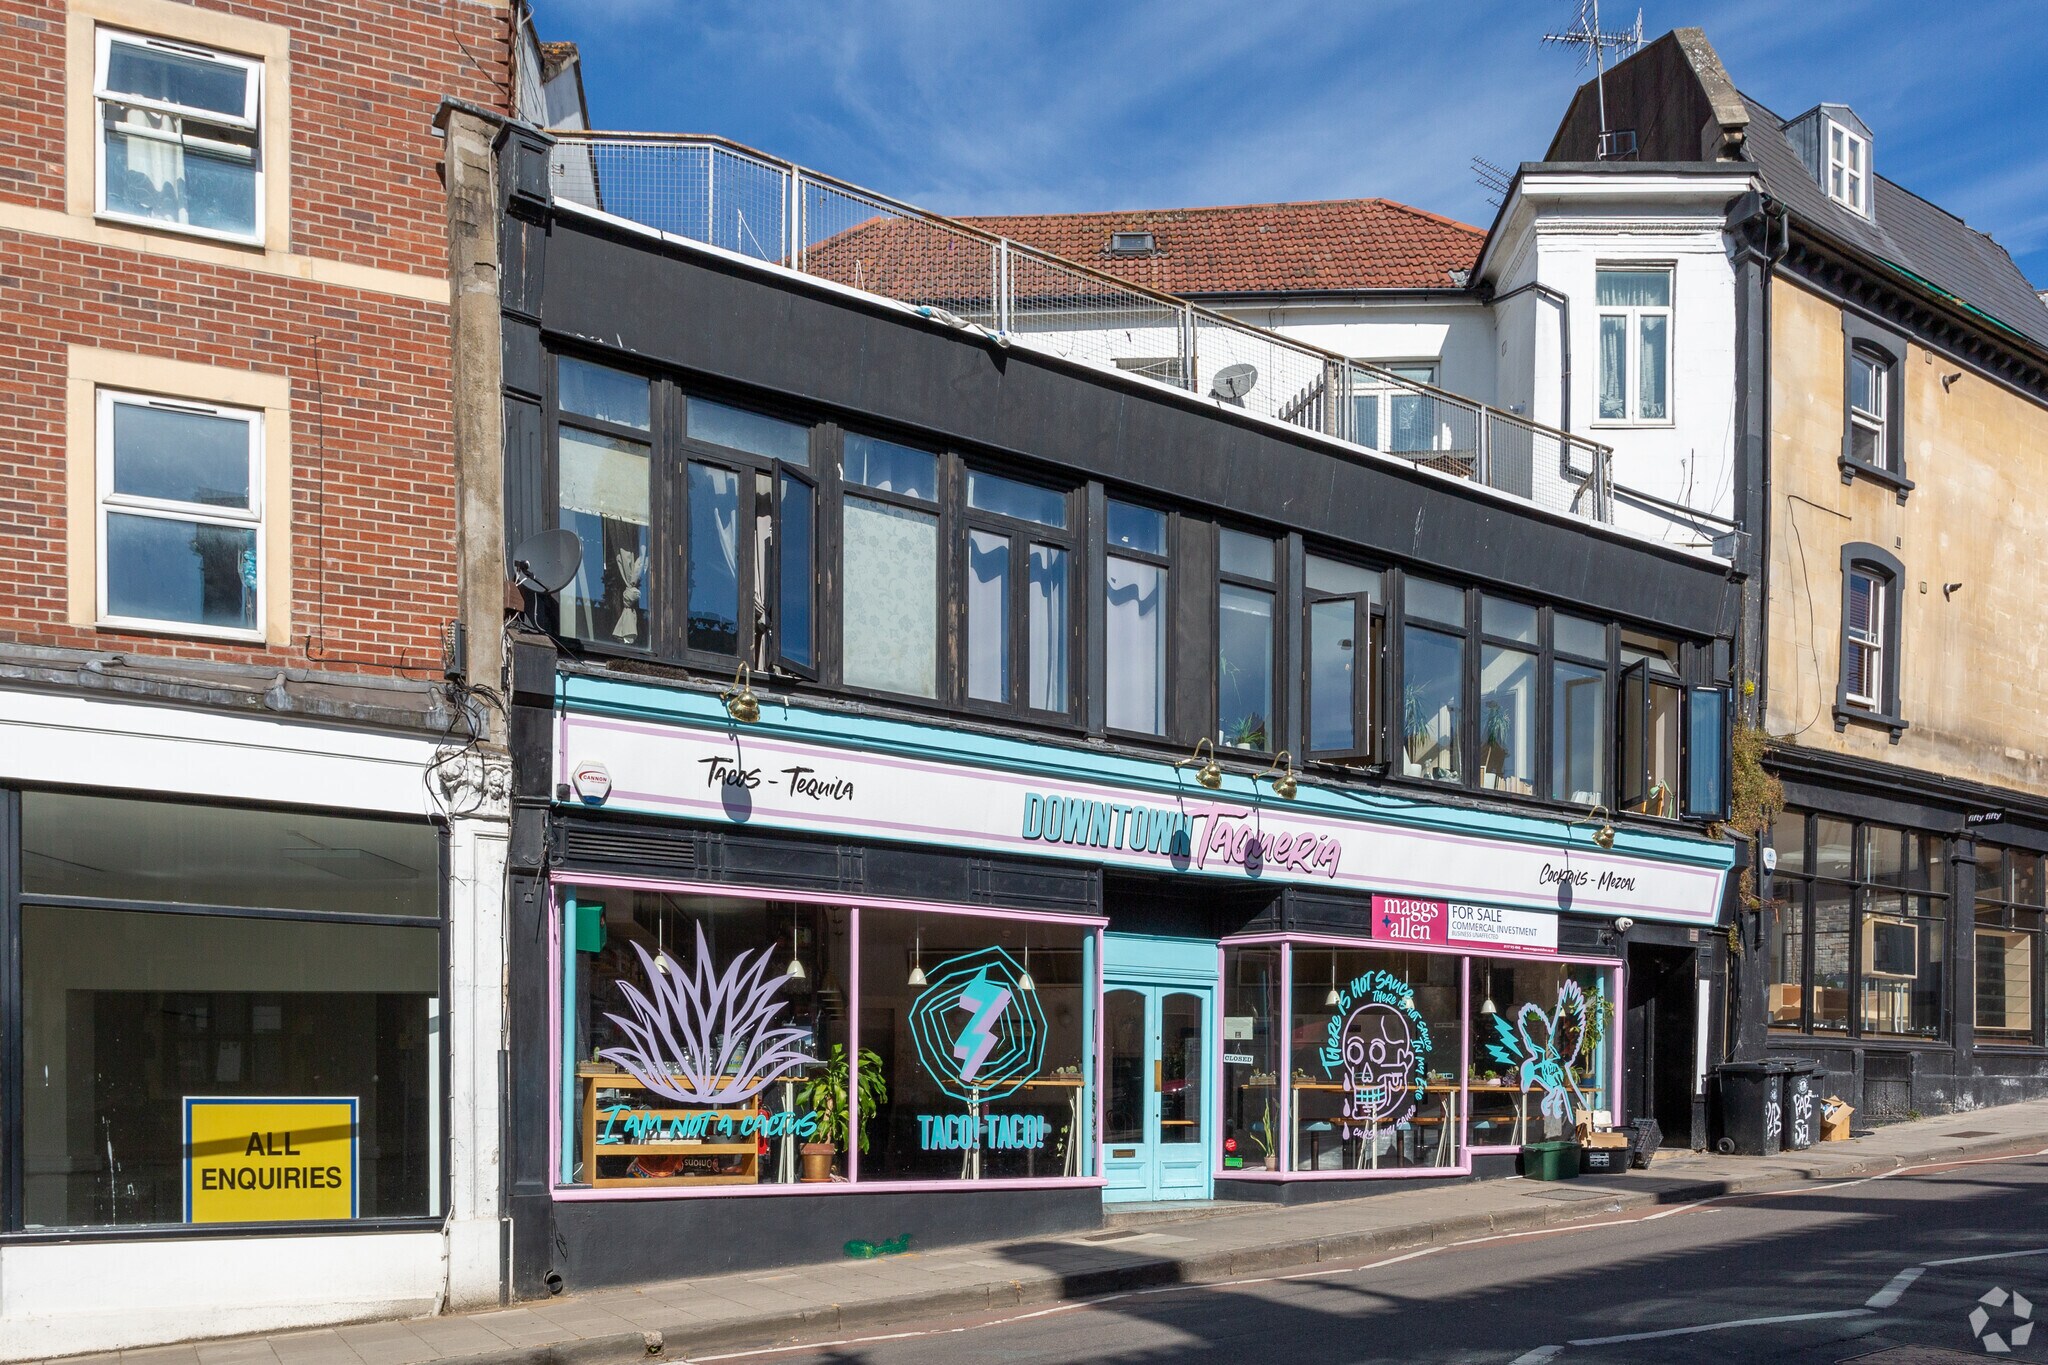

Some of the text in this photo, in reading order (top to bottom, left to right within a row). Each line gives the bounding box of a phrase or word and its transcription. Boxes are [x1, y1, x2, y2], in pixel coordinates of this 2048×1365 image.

[1022, 792, 1193, 857] DOWNTOWN
[1968, 812, 2002, 822] fifty fifty
[1384, 898, 1438, 922] maggs
[1452, 905, 1502, 923] FOR SALE
[1390, 917, 1430, 940] allen
[1451, 930, 1499, 940] BUSINESS UNAFFECTED
[1497, 925, 1538, 937] INVESTMENT
[1350, 970, 1375, 998] HOT
[1224, 1055, 1252, 1063] CLOSED
[597, 1104, 631, 1145] I
[623, 1111, 662, 1140] AM
[669, 1111, 719, 1139] NOT
[717, 1114, 733, 1138] A
[916, 1114, 1045, 1150] TACO! TACO!
[245, 1131, 300, 1156] ALL
[684, 1158, 713, 1169] Onions
[201, 1166, 342, 1190] ENQUIRIES
